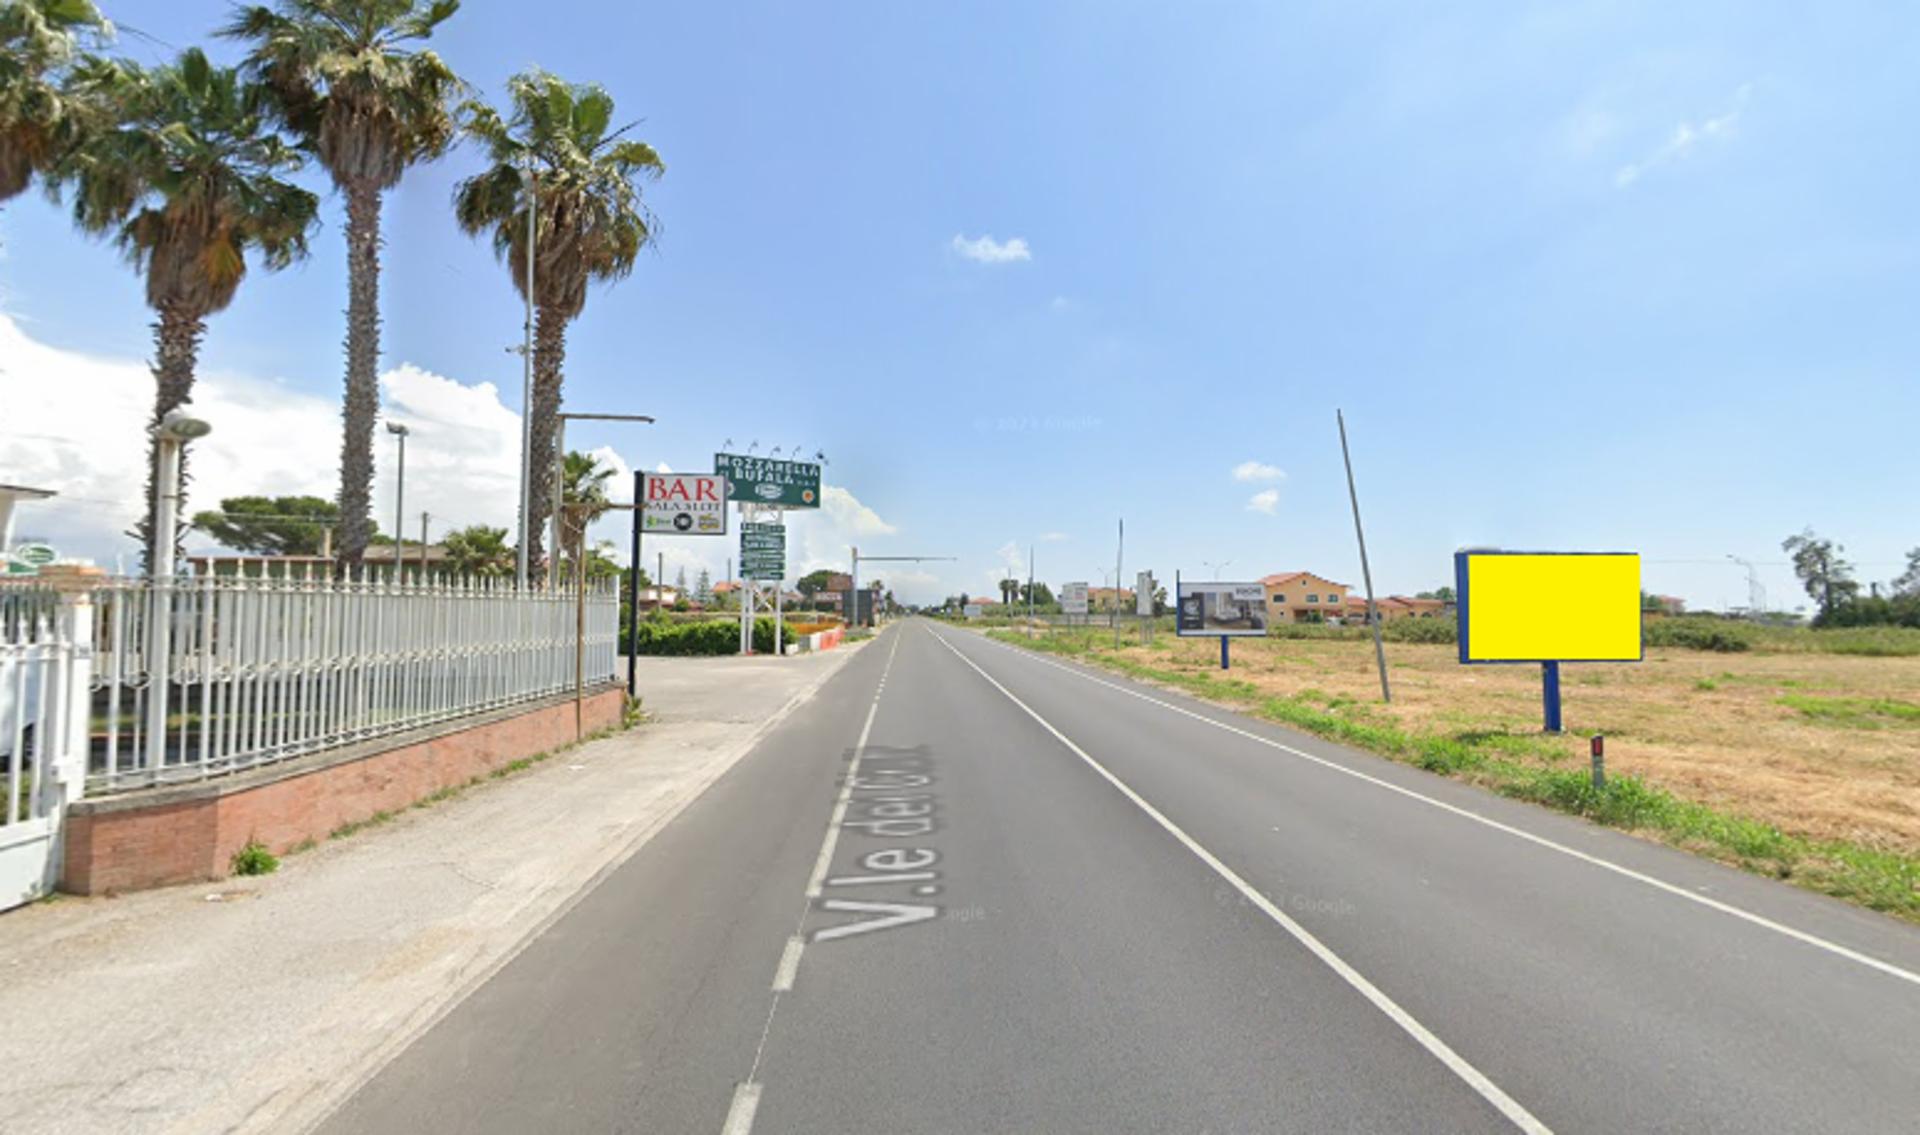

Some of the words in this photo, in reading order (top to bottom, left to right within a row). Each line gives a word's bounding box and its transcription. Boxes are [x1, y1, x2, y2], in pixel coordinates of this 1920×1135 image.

[717, 455, 819, 477] MOZZARELLA
[734, 466, 794, 485] BUFALA
[648, 477, 719, 502] BAR
